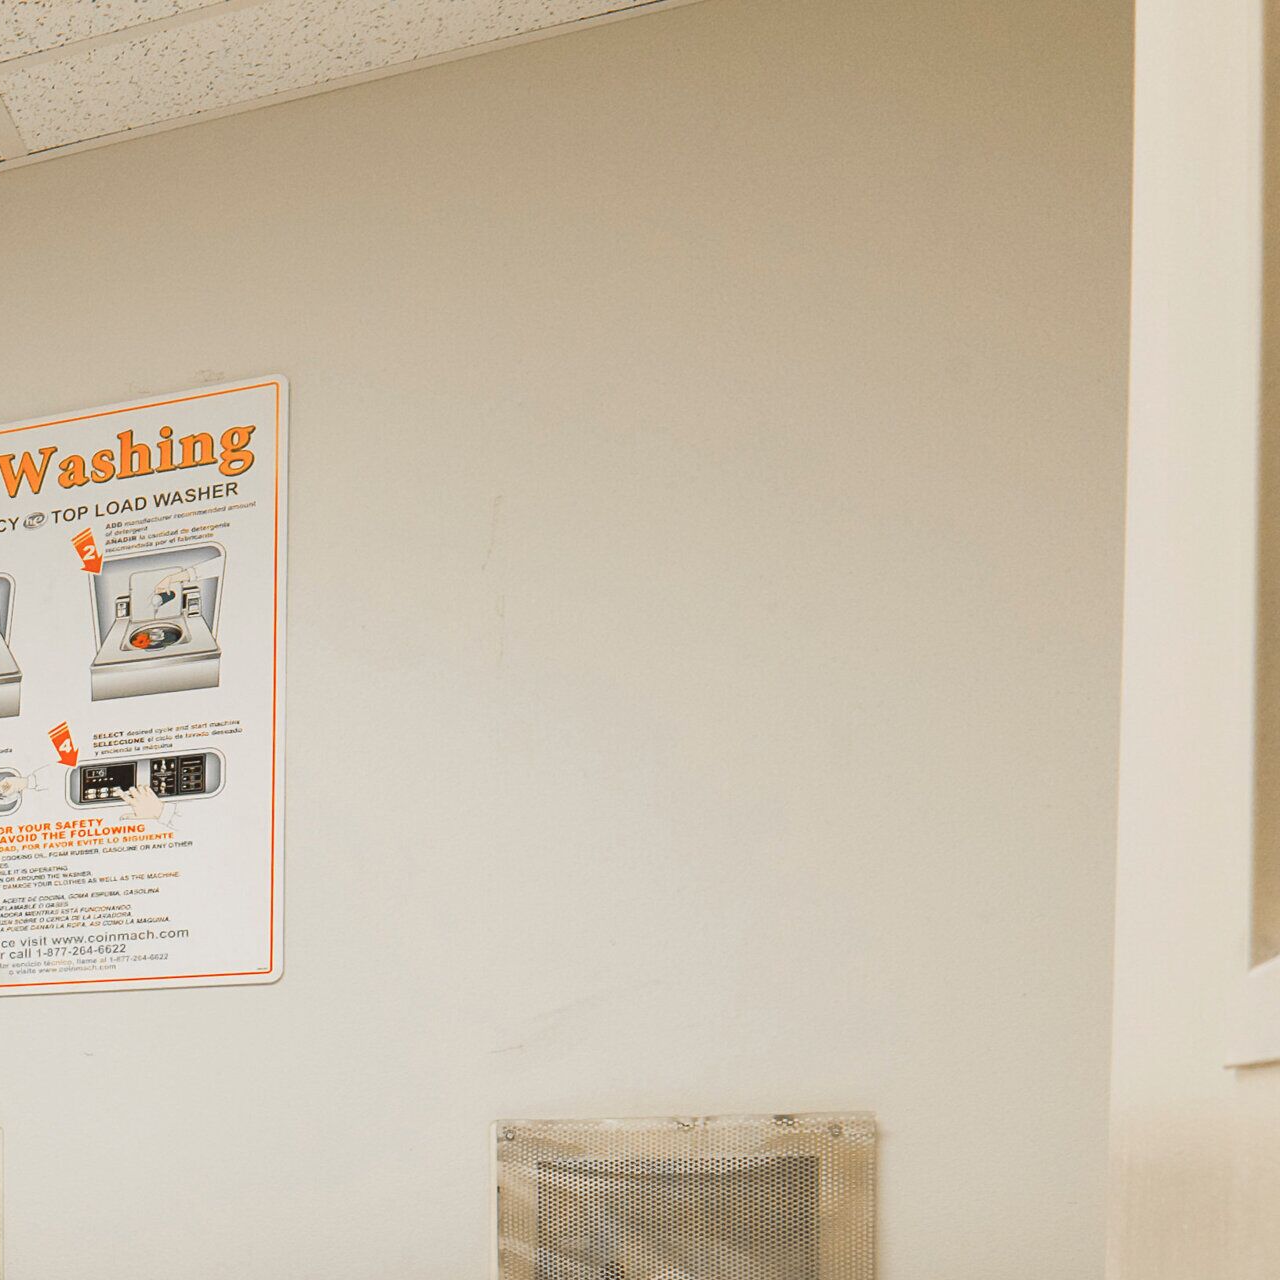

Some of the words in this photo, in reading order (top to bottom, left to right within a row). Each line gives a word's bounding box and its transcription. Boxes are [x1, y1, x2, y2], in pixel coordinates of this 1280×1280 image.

[52, 506, 88, 524] TOP
[95, 496, 147, 517] LOAD
[152, 482, 238, 508] WASHER
[106, 521, 122, 529] ADD
[83, 546, 95, 560] 2
[93, 732, 124, 740] SELECT
[58, 738, 72, 753] 4
[18, 822, 51, 832] YOUR
[55, 819, 104, 830] SAFETY
[0, 834, 37, 844] AVOID
[42, 829, 65, 840] THE
[70, 824, 145, 838] FOLLOWING
[20, 936, 47, 946] visit
[52, 928, 189, 944] www.coinmach.com
[9, 949, 31, 959] call
[36, 944, 126, 957] 1-877-264-6622
